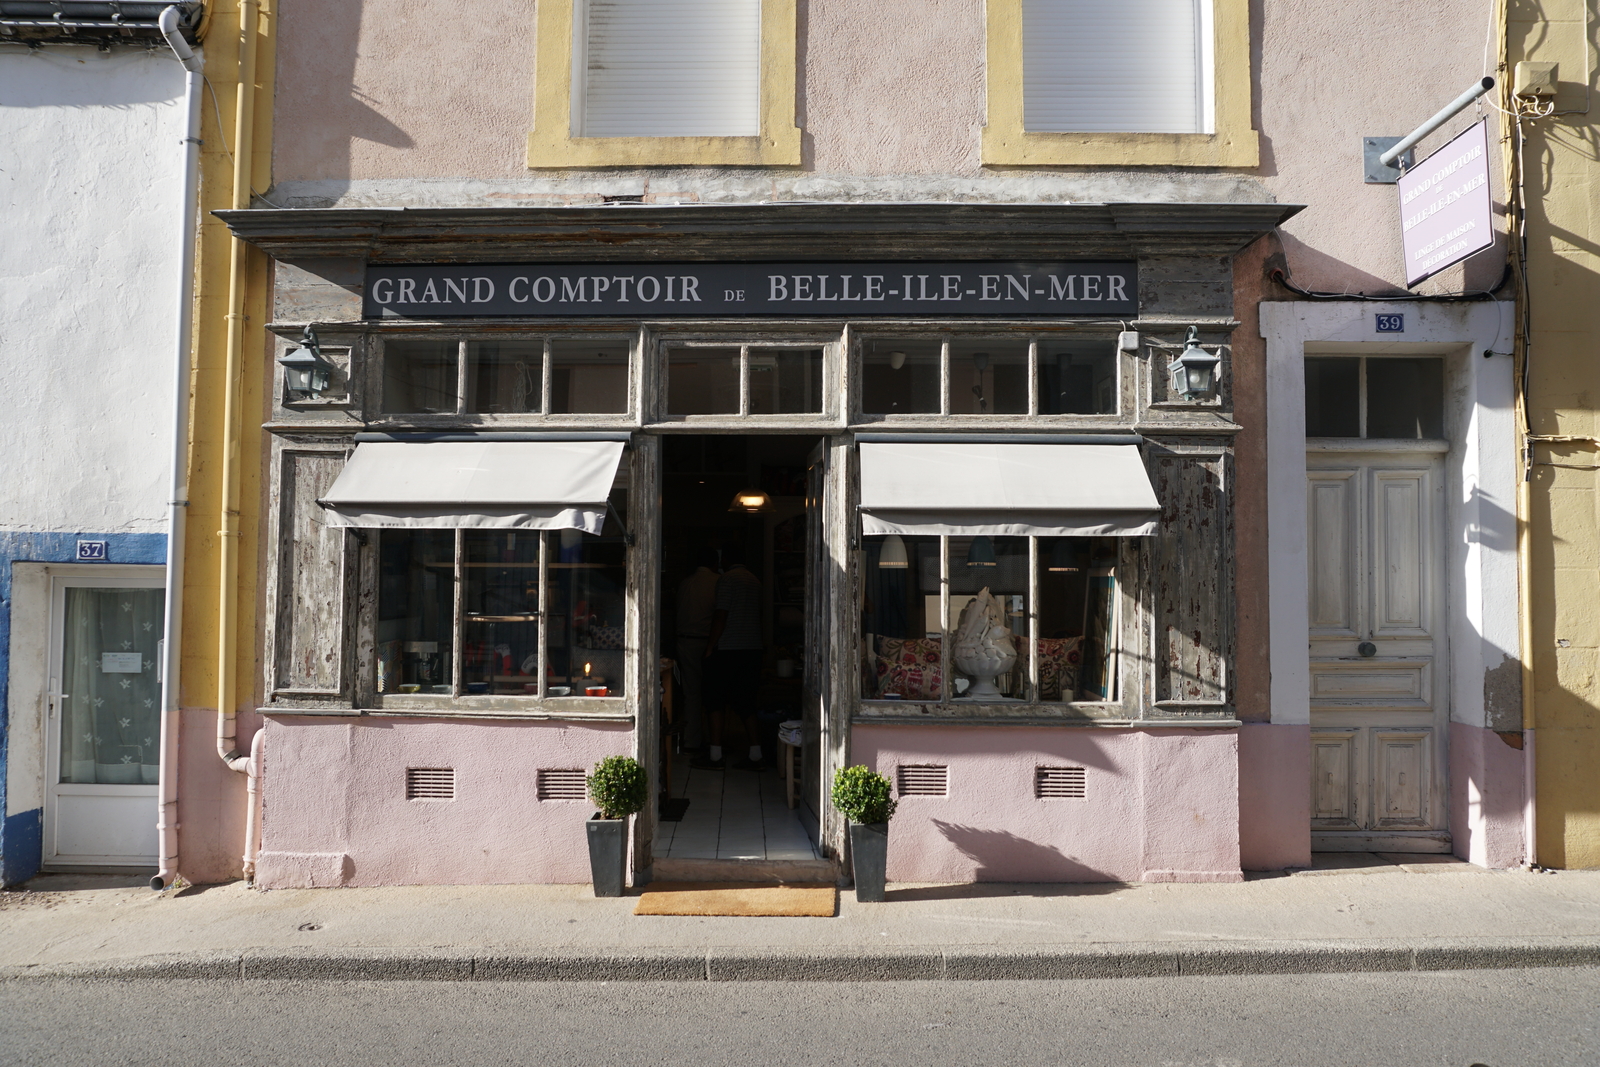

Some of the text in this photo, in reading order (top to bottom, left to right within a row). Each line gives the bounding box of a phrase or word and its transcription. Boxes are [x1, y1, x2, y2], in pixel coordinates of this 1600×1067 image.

[1403, 145, 1482, 205] GRAND COMPTOIR
[1435, 184, 1444, 195] DE
[1403, 173, 1486, 233] BELLE-ILE-EN-MER
[1414, 219, 1476, 261] LINGE DE MAISON
[1422, 238, 1468, 271] DÉCORATION
[372, 274, 1130, 304] GRAND COMPTOIR DE BELLE-ILE-EN-MER
[1380, 316, 1400, 330] 39
[81, 543, 101, 557] 37
